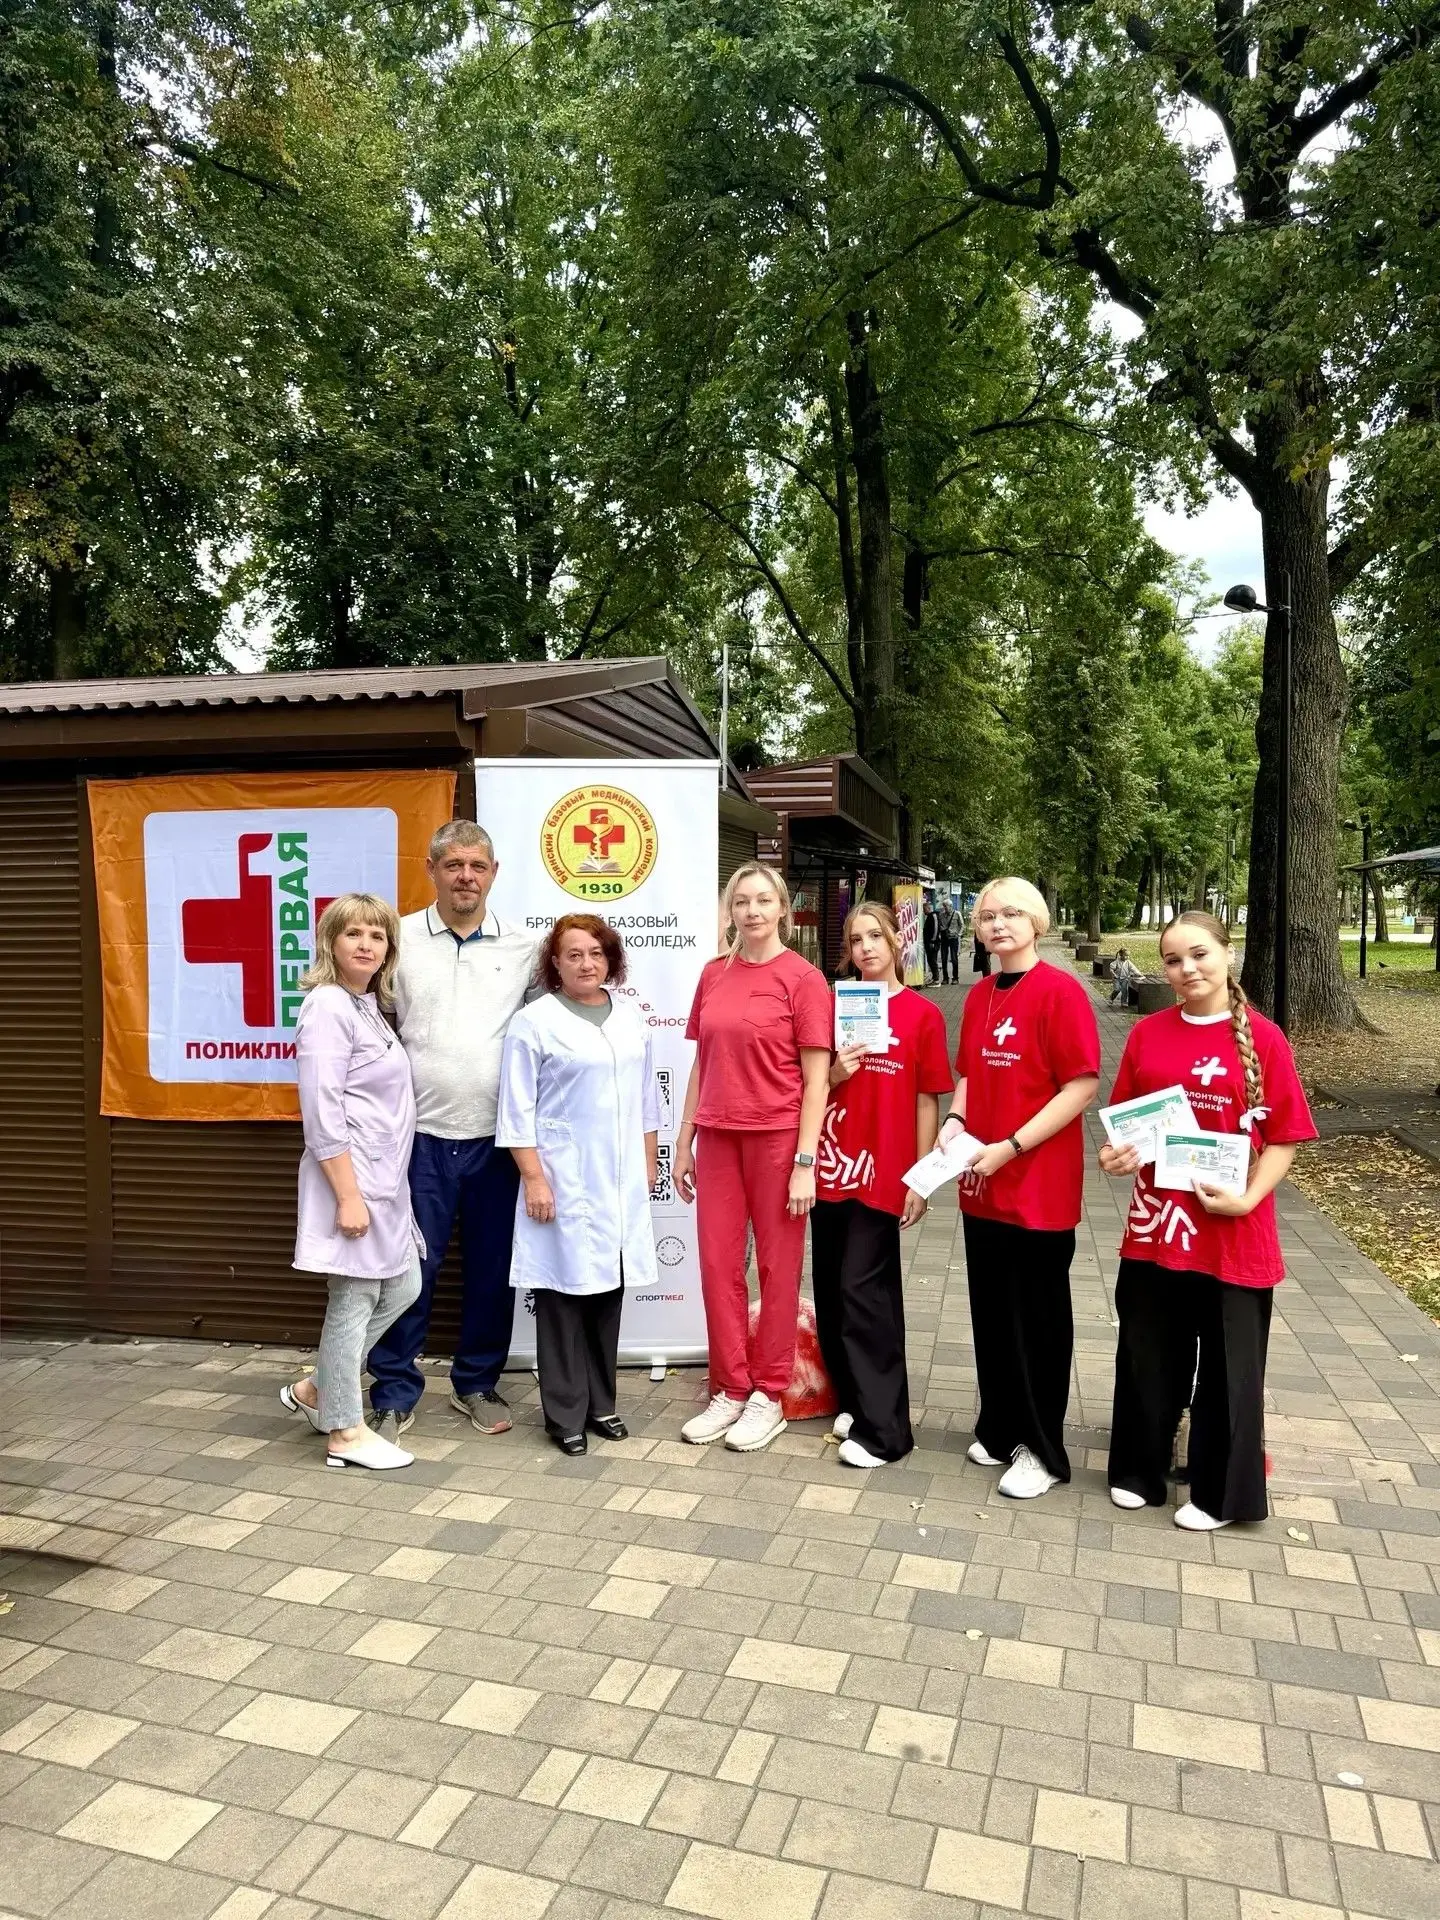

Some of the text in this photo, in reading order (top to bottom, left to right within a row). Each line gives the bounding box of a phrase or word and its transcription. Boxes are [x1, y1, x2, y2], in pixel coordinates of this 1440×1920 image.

[544, 790, 653, 885] Брянский базовый медицинский колледж
[579, 883, 623, 894] 1930
[608, 913, 678, 928] БАЗОВЫЙ
[277, 832, 310, 1027] ПЕРВАЯ
[625, 935, 696, 949] КОЛЛЕДЖ
[186, 1042, 297, 1059] ПОЛИКЛИ
[981, 1047, 1021, 1060] Волонтеры
[860, 1055, 904, 1070] Волонтеры
[865, 1064, 896, 1075] медики
[1184, 1090, 1233, 1105] олонтеры
[1189, 1100, 1223, 1112] едики
[635, 1294, 684, 1302] СПОРТМЕД
